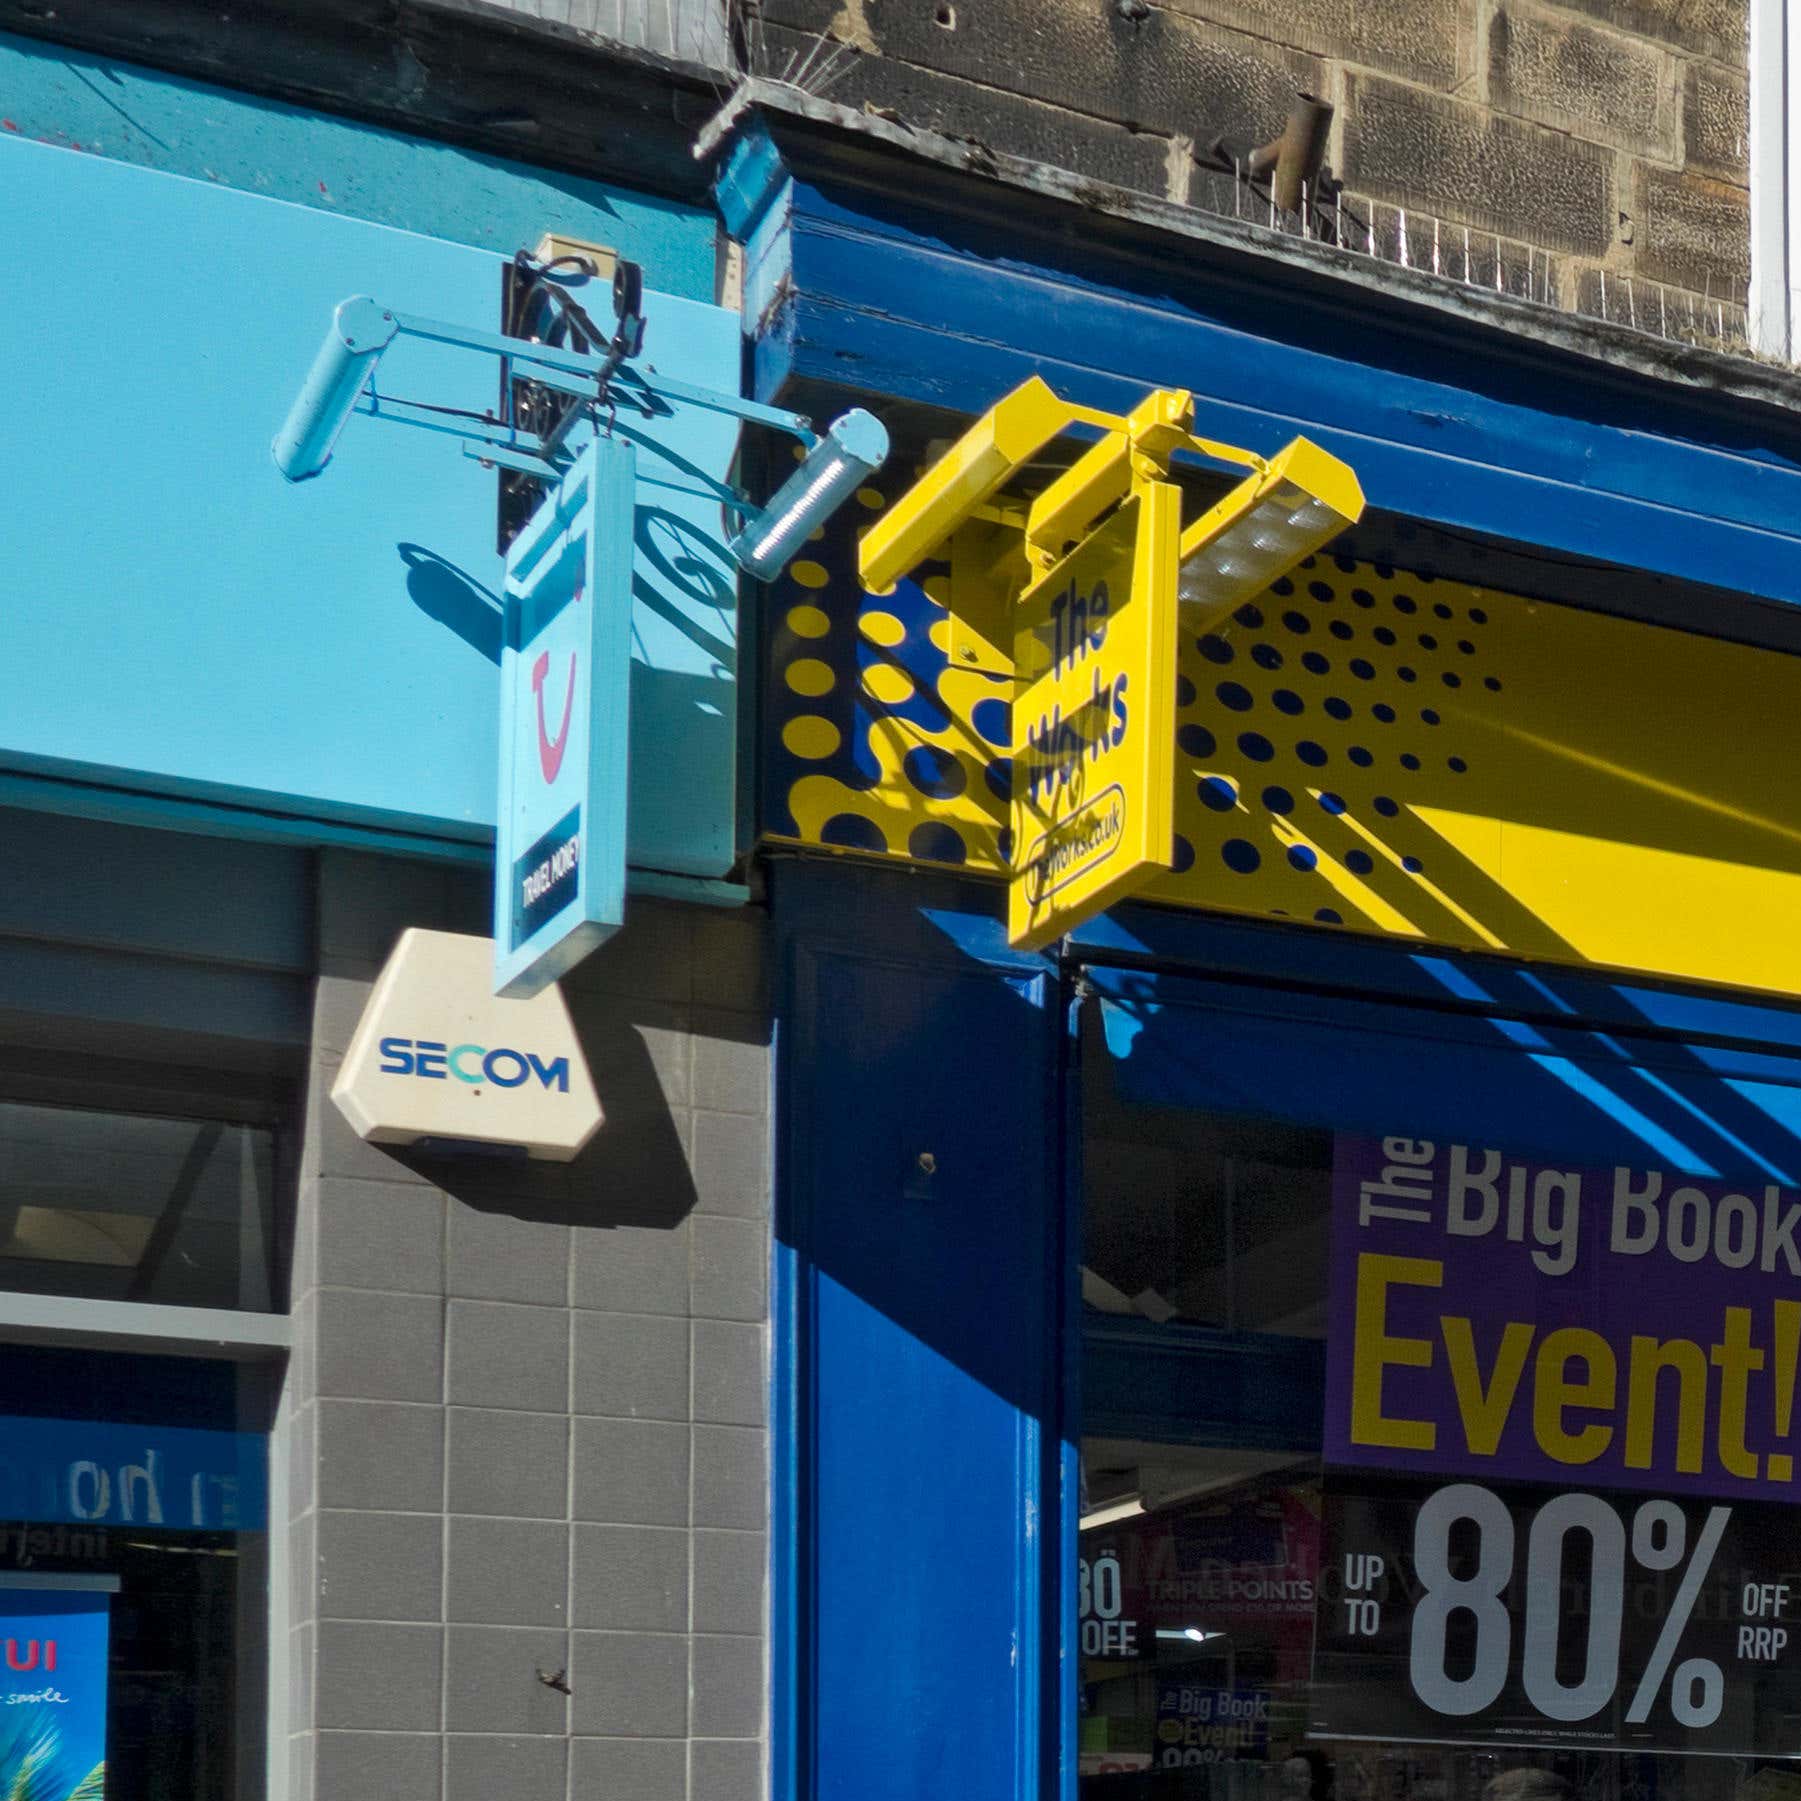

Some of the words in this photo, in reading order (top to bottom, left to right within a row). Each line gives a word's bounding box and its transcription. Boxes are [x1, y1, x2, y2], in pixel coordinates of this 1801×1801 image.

[1051, 574, 1109, 685] The
[1027, 670, 1129, 815] Works
[378, 1037, 570, 1094] SECOM
[1358, 1135, 1434, 1229] The
[1344, 1551, 1386, 1592] UP
[1408, 1481, 1733, 1728] 80%
[1344, 1596, 1382, 1636] TO
[1743, 1582, 1791, 1618] OFF
[1738, 1625, 1788, 1662] RRP
